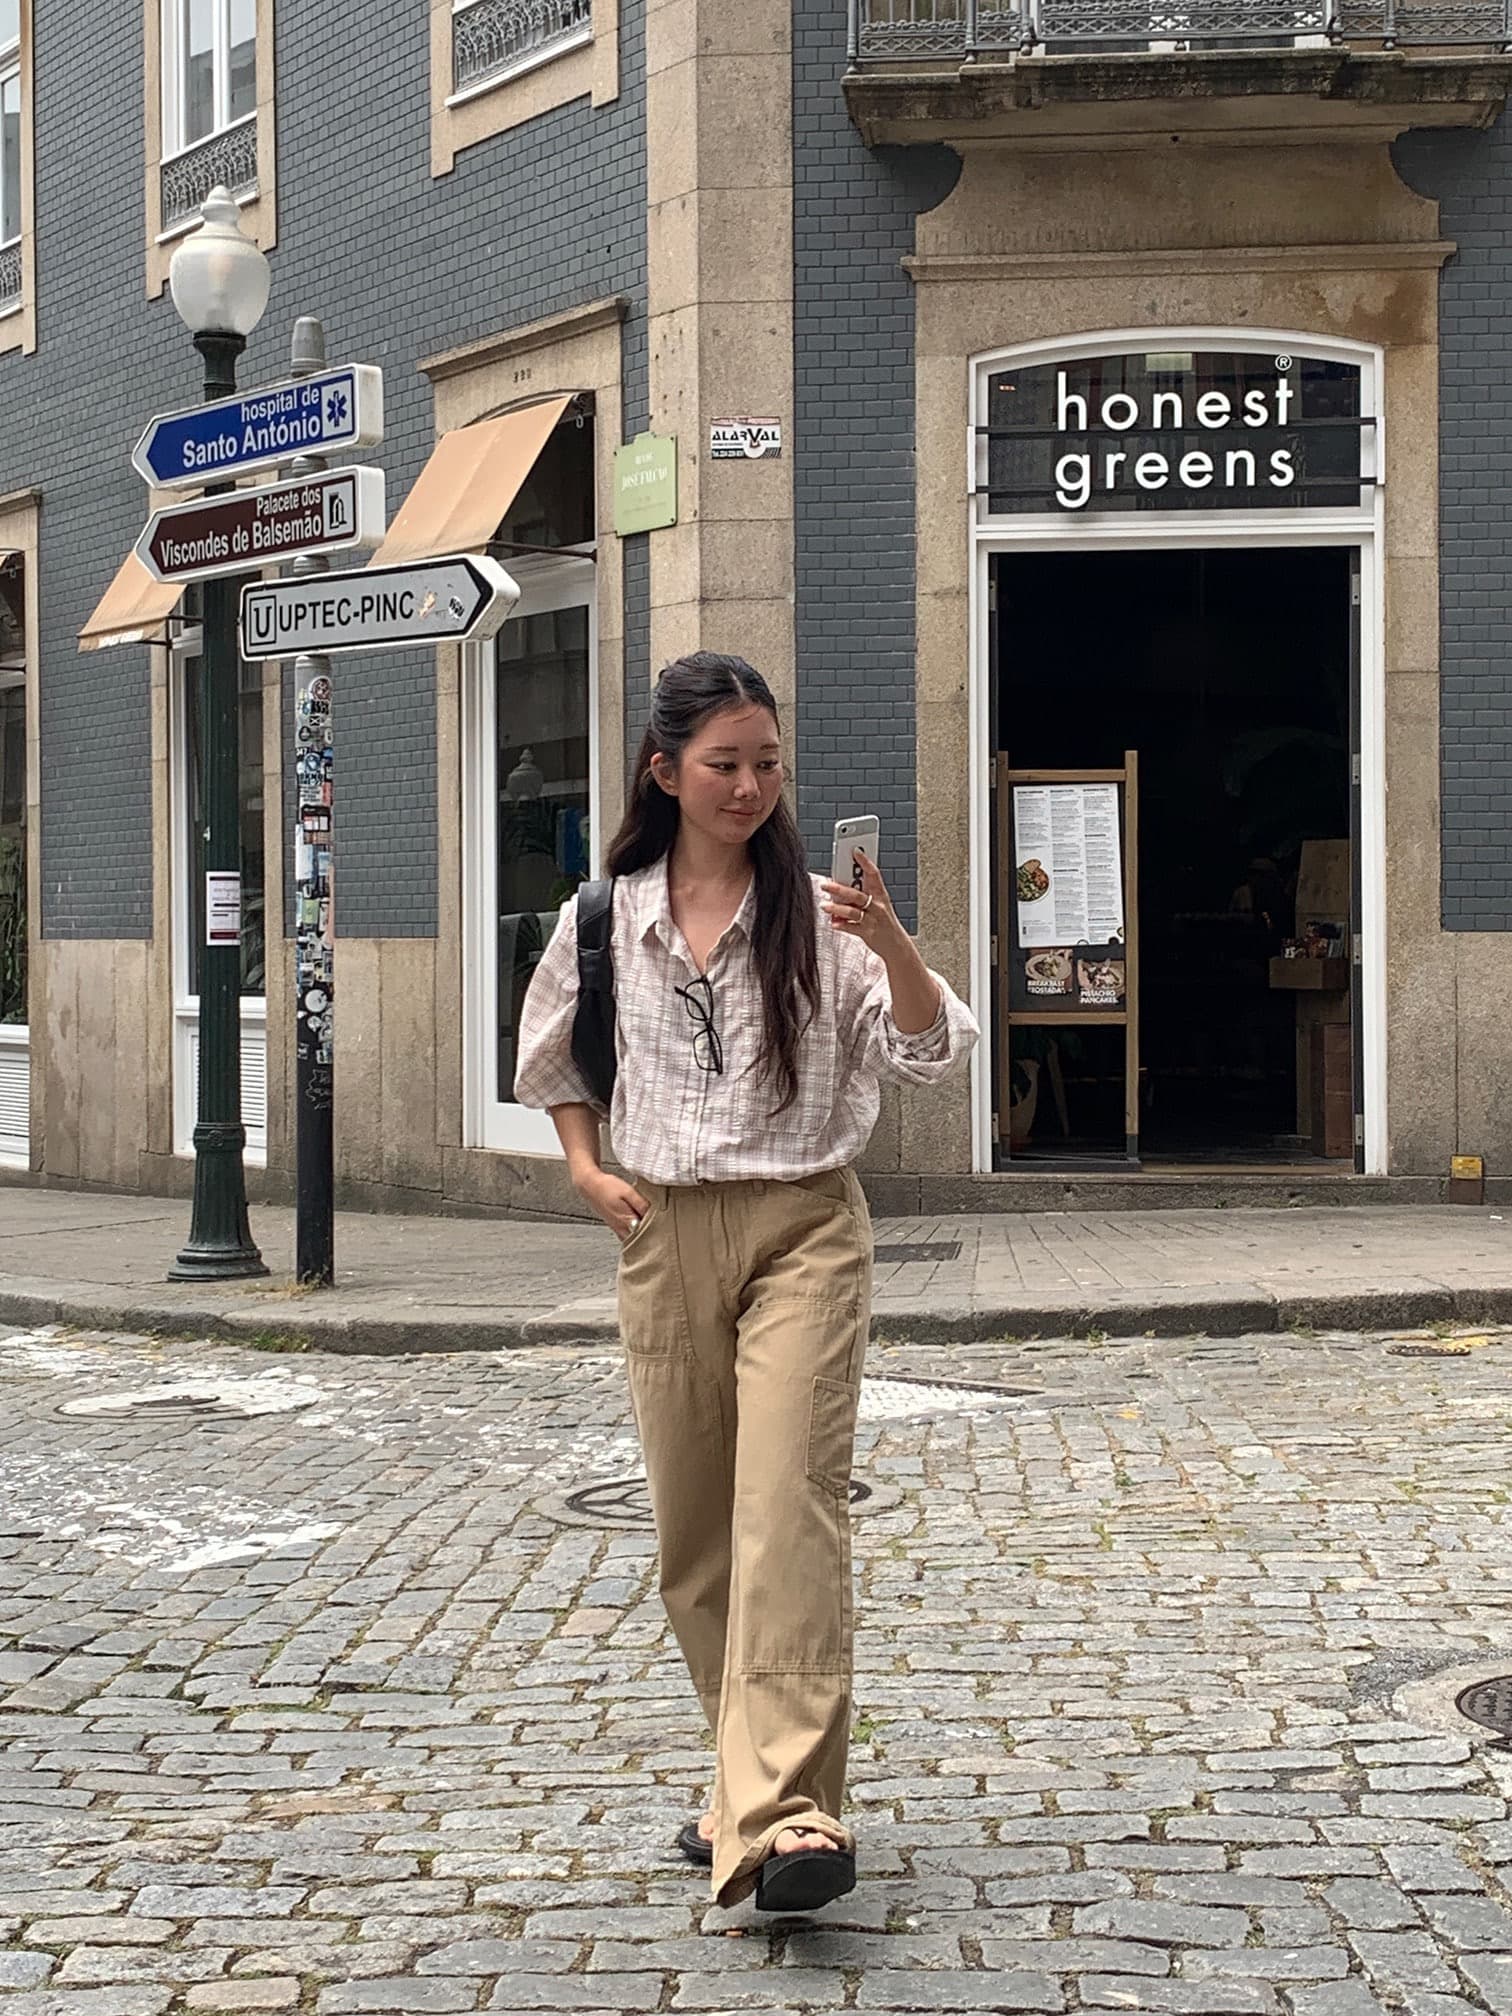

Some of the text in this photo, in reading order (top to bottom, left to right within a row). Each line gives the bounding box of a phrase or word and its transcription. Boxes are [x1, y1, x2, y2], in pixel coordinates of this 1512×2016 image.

[240, 384, 320, 423] hospital de
[1056, 371, 1294, 432] honest
[182, 411, 321, 469] Santo António
[712, 428, 779, 442] ALARVAL
[256, 486, 321, 517] Palacete dos
[1054, 447, 1295, 508] greens
[160, 510, 322, 567] Viscondes de Balsemão
[279, 590, 414, 632] UPTEC-PINC
